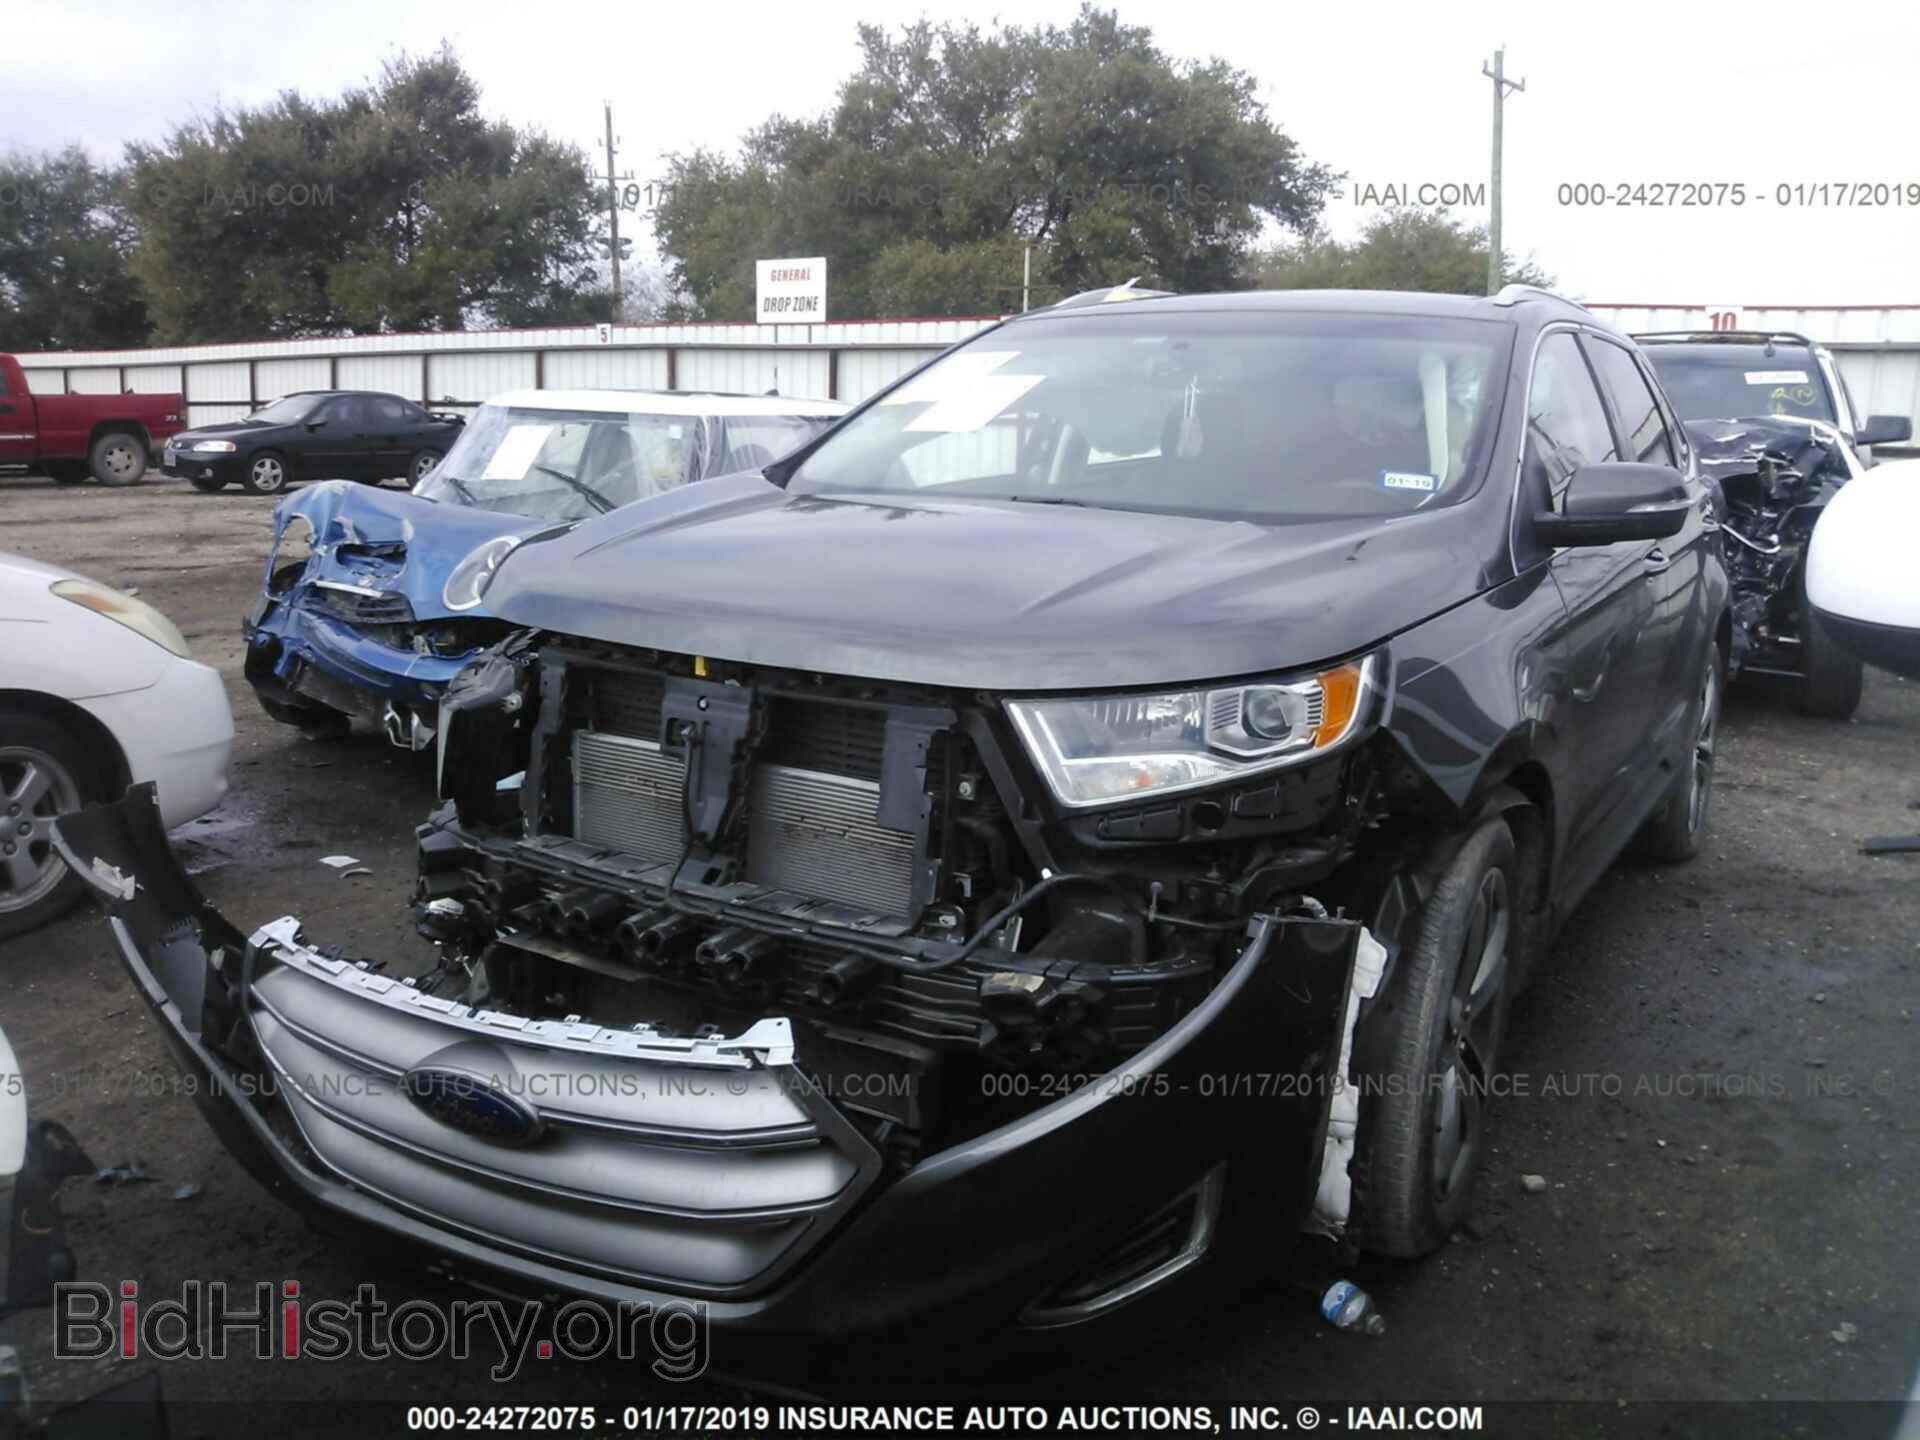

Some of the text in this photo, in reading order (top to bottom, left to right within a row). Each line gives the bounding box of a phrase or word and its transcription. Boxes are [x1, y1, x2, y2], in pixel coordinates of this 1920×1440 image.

[770, 267, 811, 282] GENERAL
[763, 295, 819, 313] DROP ZONE
[1709, 311, 1737, 331] 10
[600, 326, 609, 343] 5
